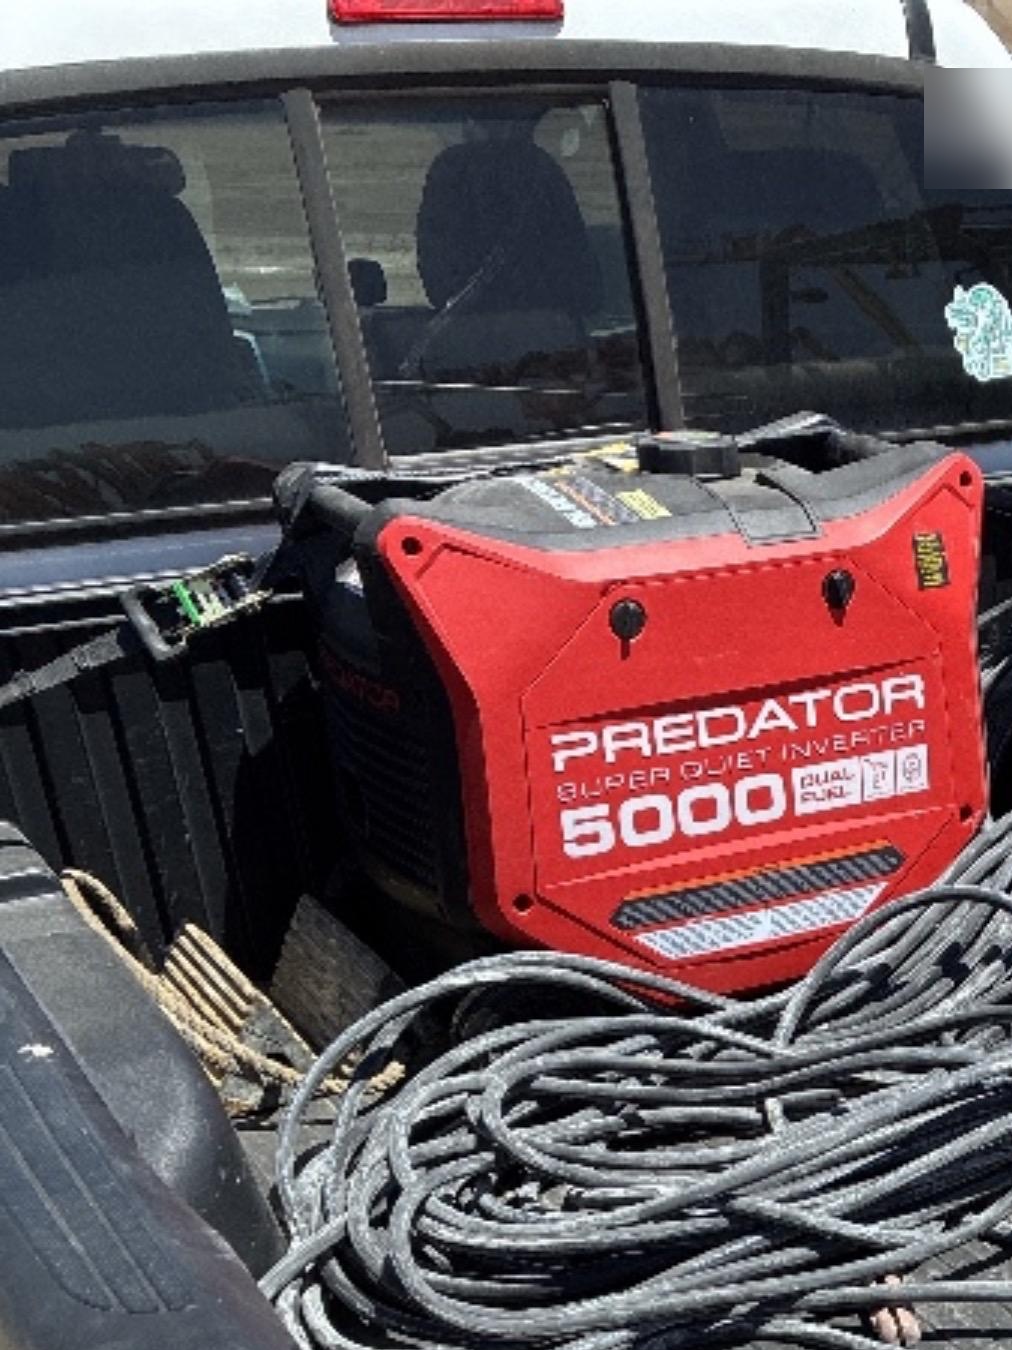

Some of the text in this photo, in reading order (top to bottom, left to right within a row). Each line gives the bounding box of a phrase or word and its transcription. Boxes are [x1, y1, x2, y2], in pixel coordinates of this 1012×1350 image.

[551, 673, 925, 772] PREDATOR
[557, 719, 926, 802] SUPER QUIET INVERTER
[560, 773, 787, 859] 5000
[799, 784, 852, 804] FUEL
[800, 770, 855, 790] DUAL
